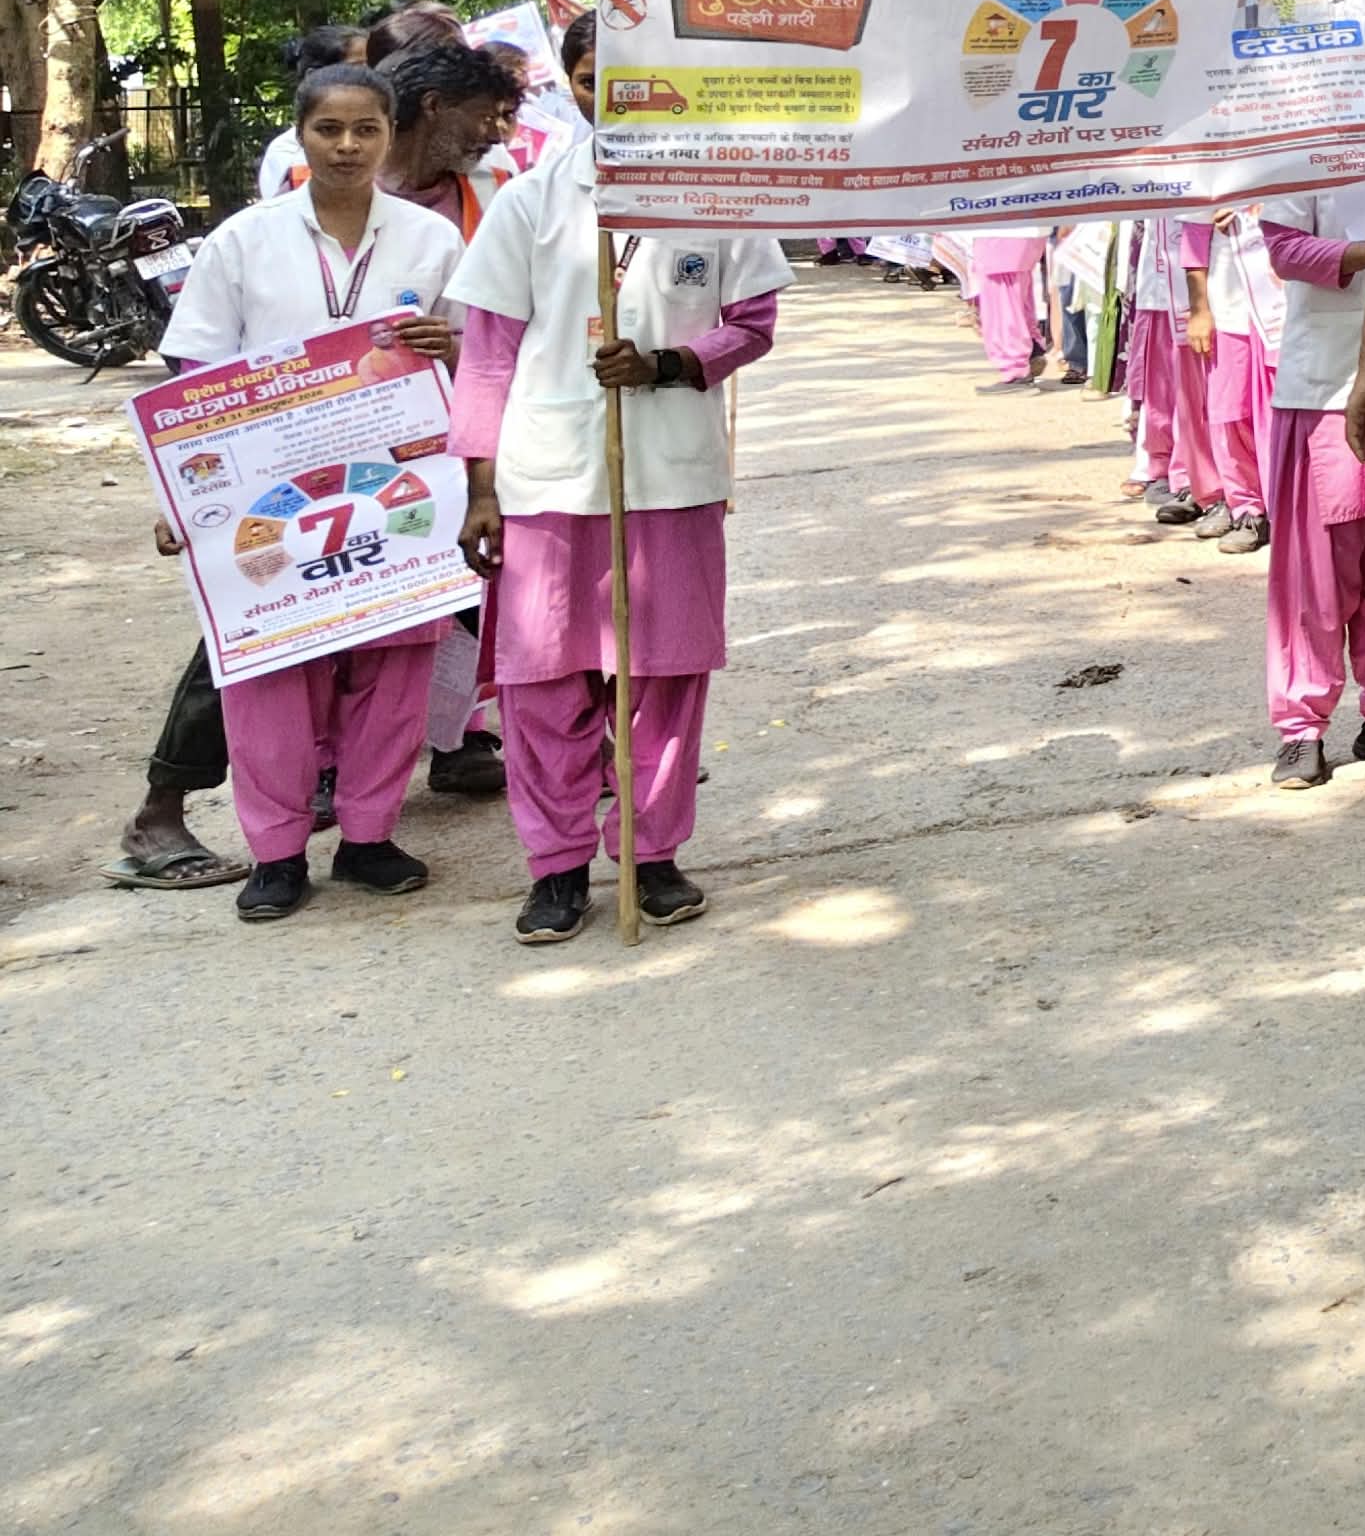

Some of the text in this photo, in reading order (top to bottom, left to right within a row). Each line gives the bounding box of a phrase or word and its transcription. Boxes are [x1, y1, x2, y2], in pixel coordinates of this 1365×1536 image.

[1034, 19, 1078, 91] 7
[1236, 27, 1359, 56] दस्तक
[1078, 71, 1116, 88] का
[1017, 87, 1117, 124] वार
[962, 123, 1165, 152] संचारी रोगों पर प्रहार
[706, 147, 850, 162] 1800-180-5145
[950, 196, 998, 212] जिला
[1001, 190, 1062, 206] स्वास्थ्य
[1132, 179, 1194, 197] जौनपुर
[280, 357, 312, 374] रोग
[153, 360, 353, 431] नियंत्रण अभियान
[298, 502, 356, 558] 7
[345, 529, 381, 550] का
[296, 538, 390, 582] वार
